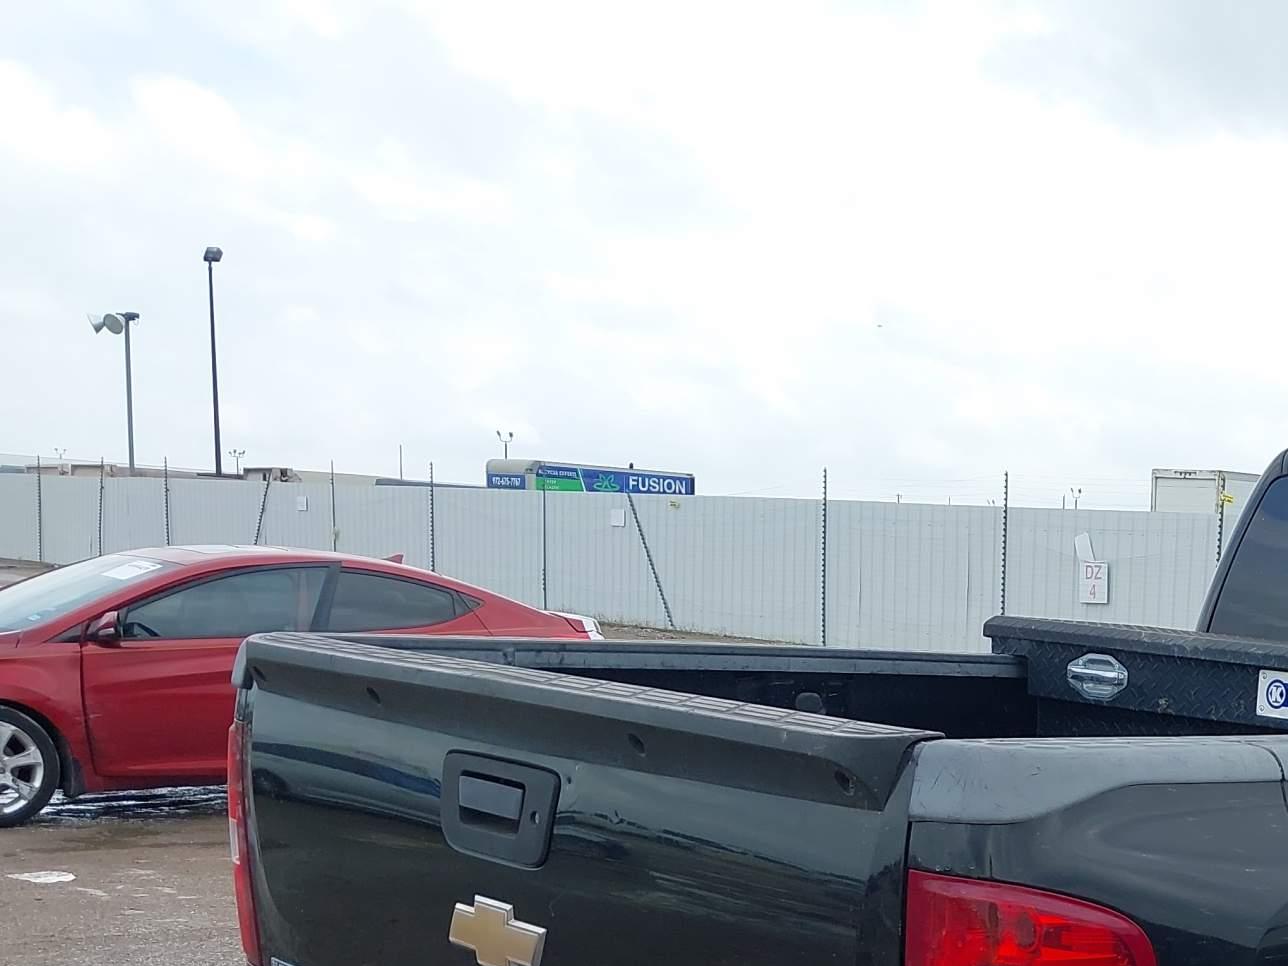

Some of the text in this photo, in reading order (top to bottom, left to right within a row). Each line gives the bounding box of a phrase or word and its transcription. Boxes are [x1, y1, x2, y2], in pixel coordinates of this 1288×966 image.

[628, 475, 687, 495] FUSION
[1085, 564, 1103, 580] DZ
[1089, 583, 1096, 600] 4
